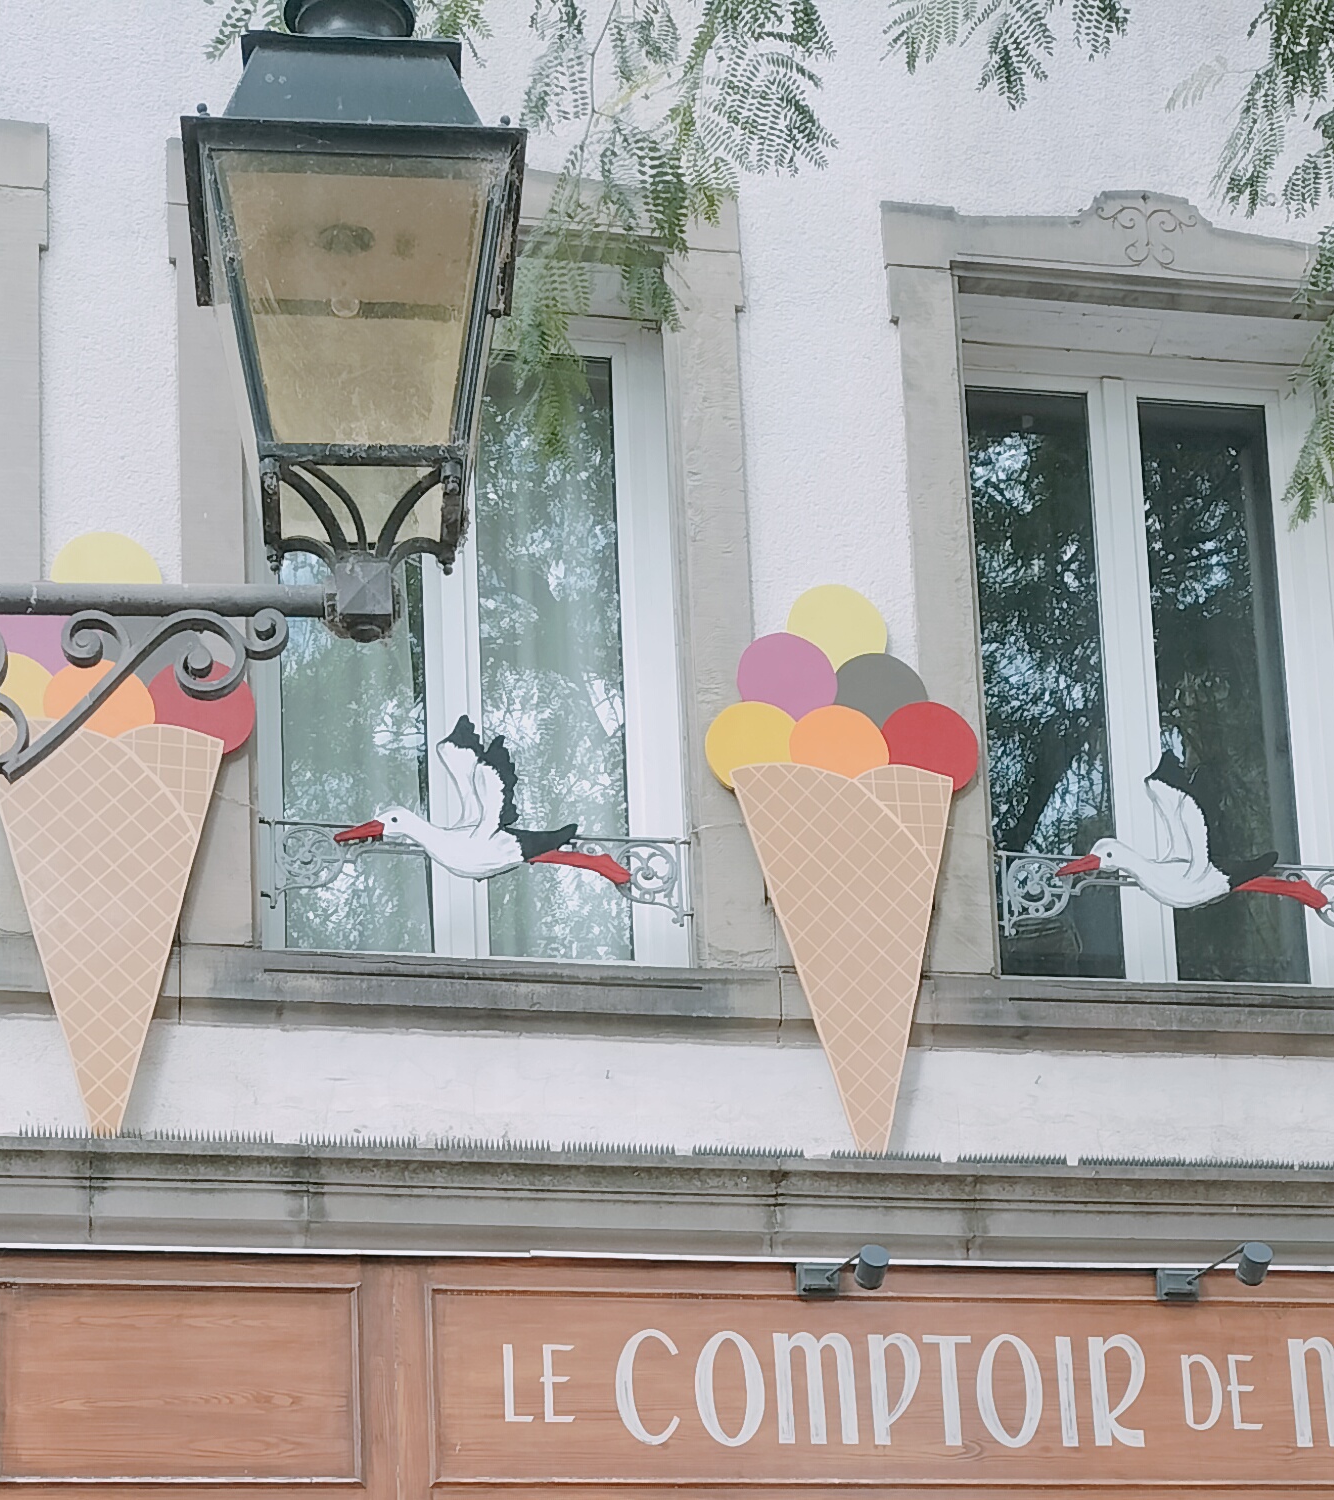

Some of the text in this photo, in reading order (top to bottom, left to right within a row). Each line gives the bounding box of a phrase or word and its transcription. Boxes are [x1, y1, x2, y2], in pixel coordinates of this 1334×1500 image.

[503, 1343, 575, 1423] LE
[615, 1328, 1147, 1447] COMPTOIR
[1180, 1354, 1264, 1431] DE
